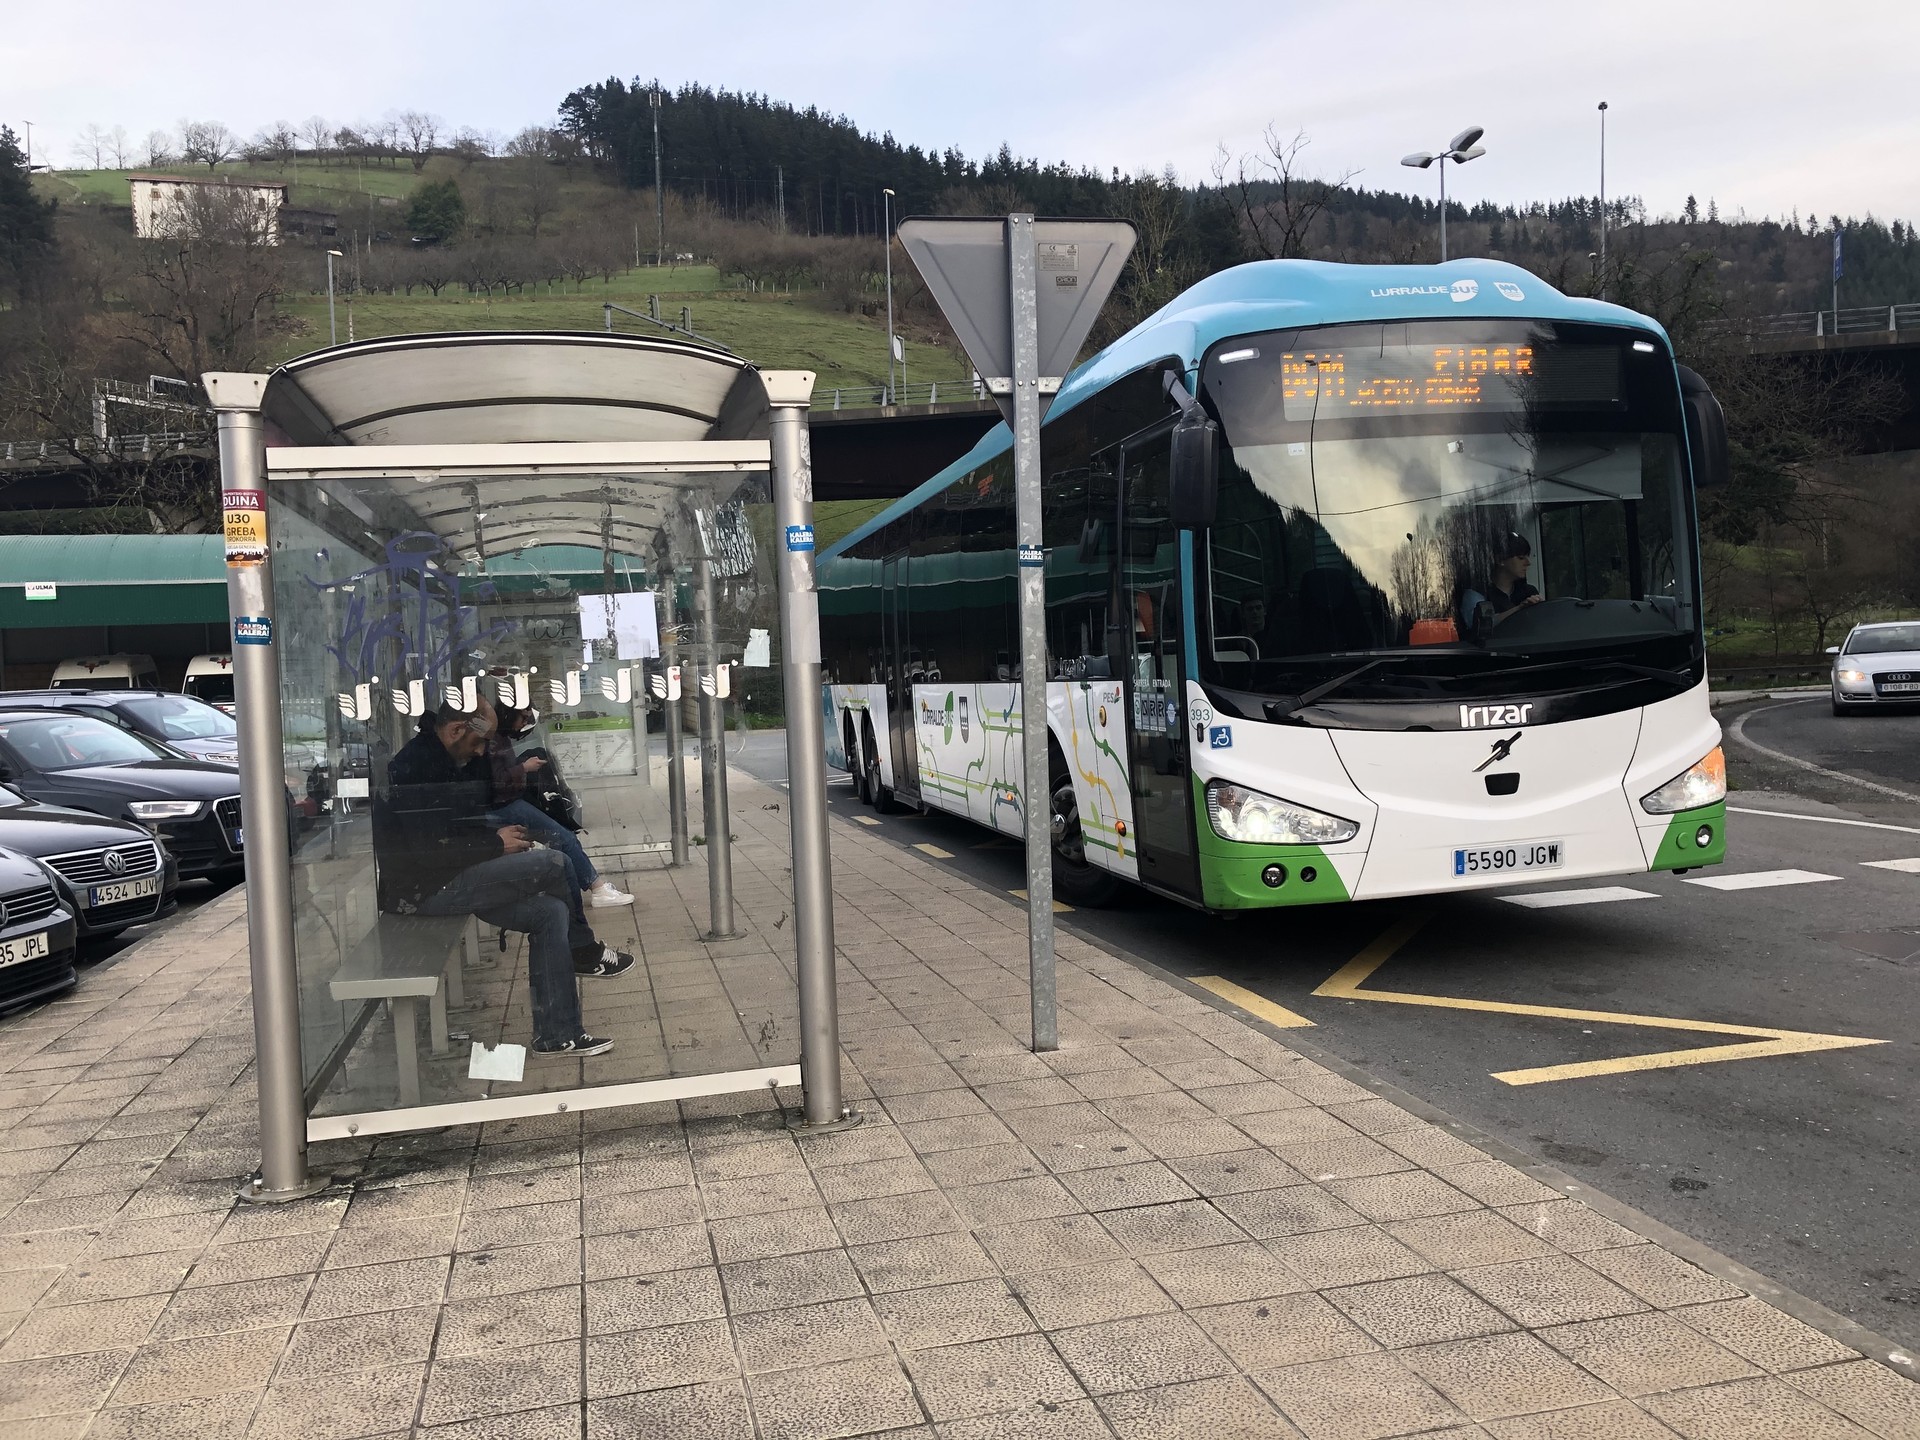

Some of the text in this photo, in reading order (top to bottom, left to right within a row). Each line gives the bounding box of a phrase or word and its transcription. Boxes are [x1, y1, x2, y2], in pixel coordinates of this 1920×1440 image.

[226, 527, 256, 537] GREBA
[1152, 679, 1172, 688] ENTRADA
[1190, 708, 1210, 721] 393
[1467, 844, 1558, 871] 5590 JGW
[98, 879, 155, 902] 4524 DJV
[22, 936, 46, 958] JPL
